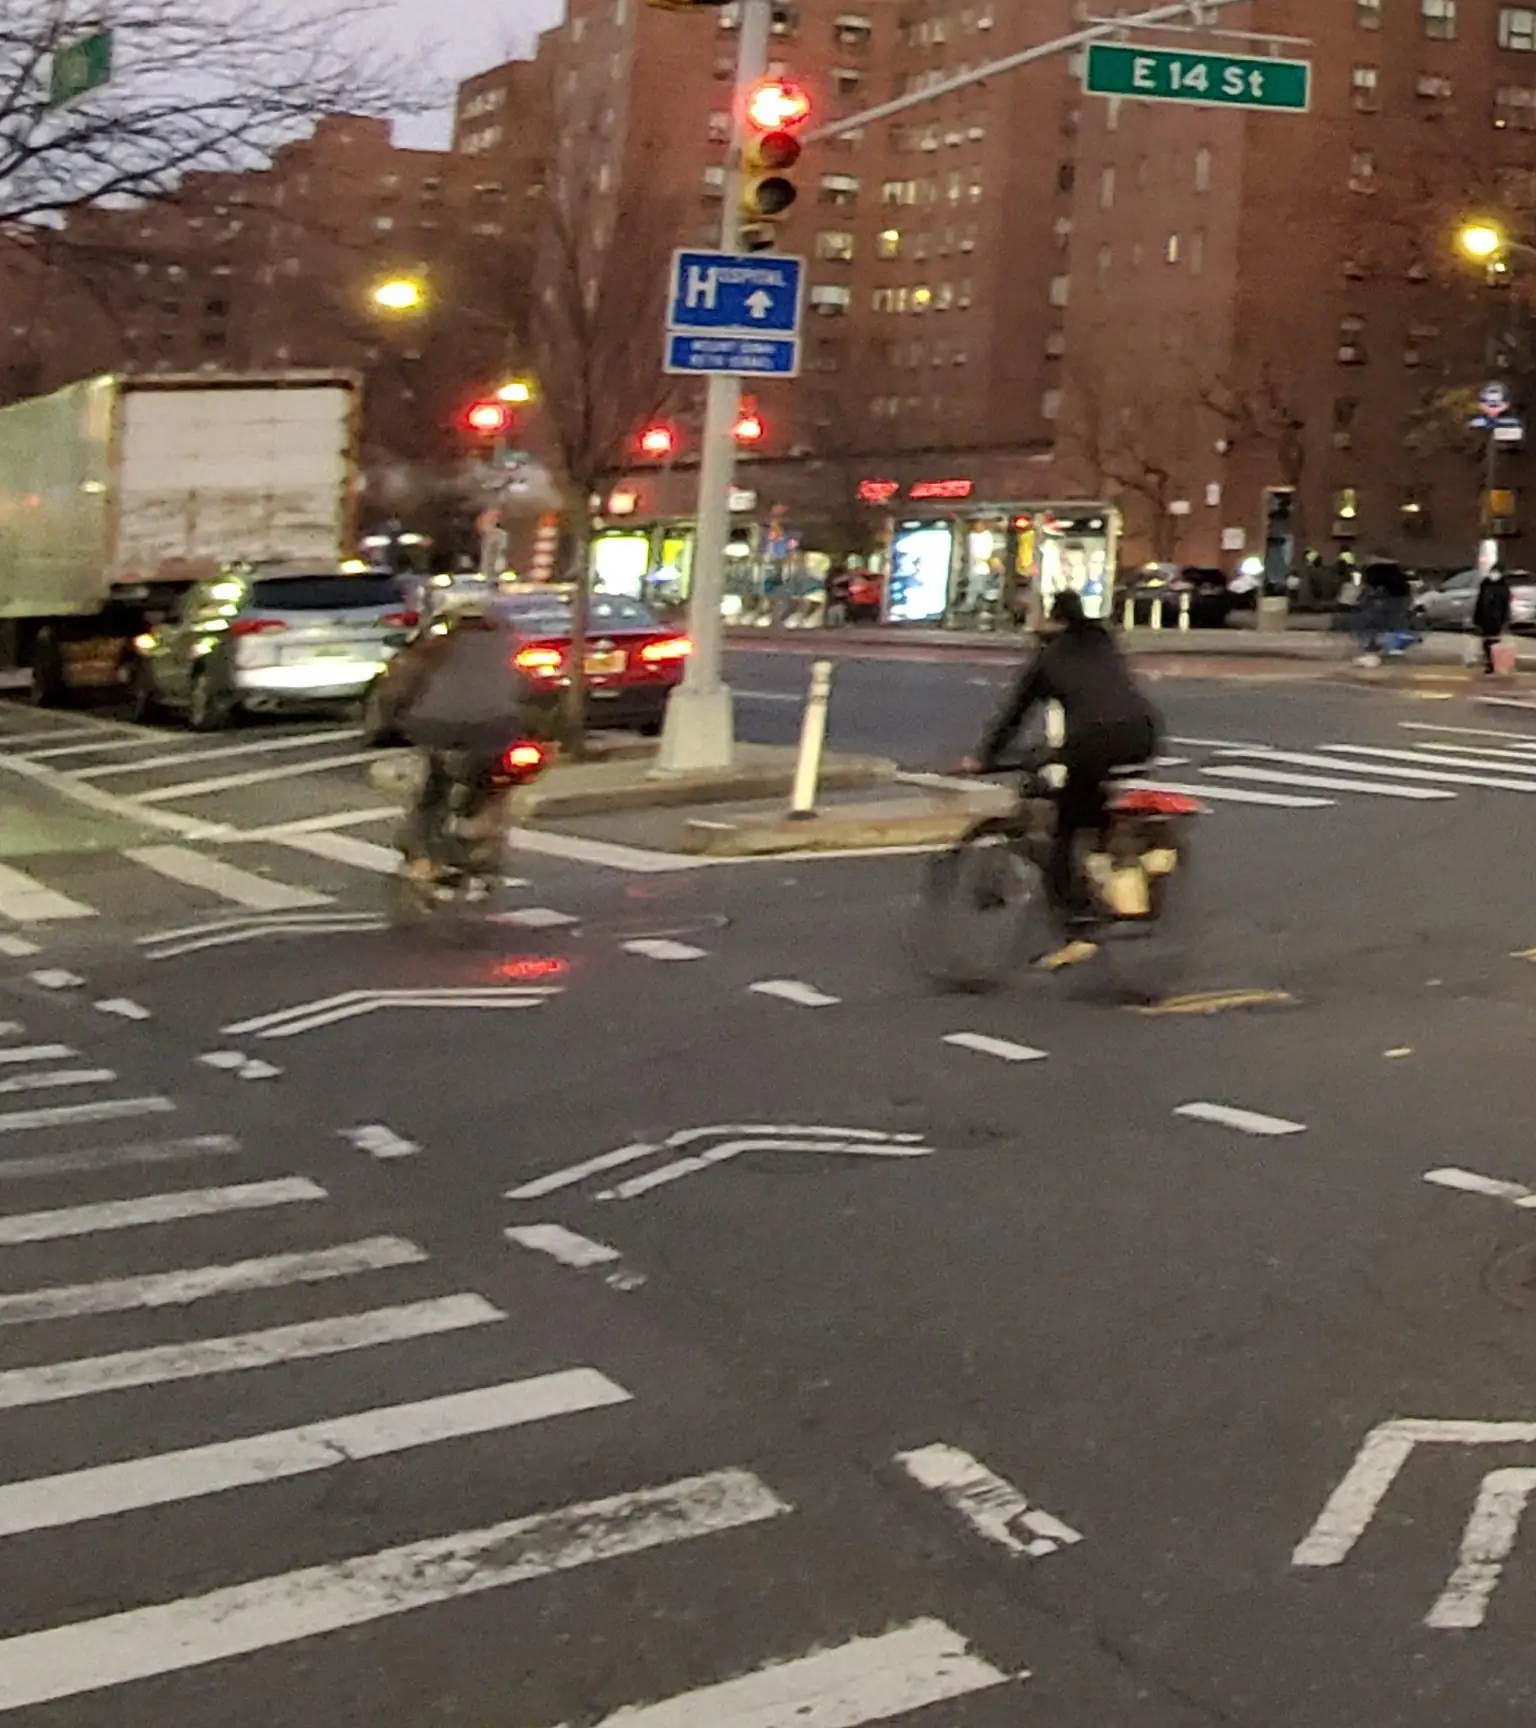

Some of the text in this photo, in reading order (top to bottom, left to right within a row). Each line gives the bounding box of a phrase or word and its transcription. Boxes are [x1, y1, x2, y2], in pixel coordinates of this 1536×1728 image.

[1133, 57, 1265, 98] E 14 St
